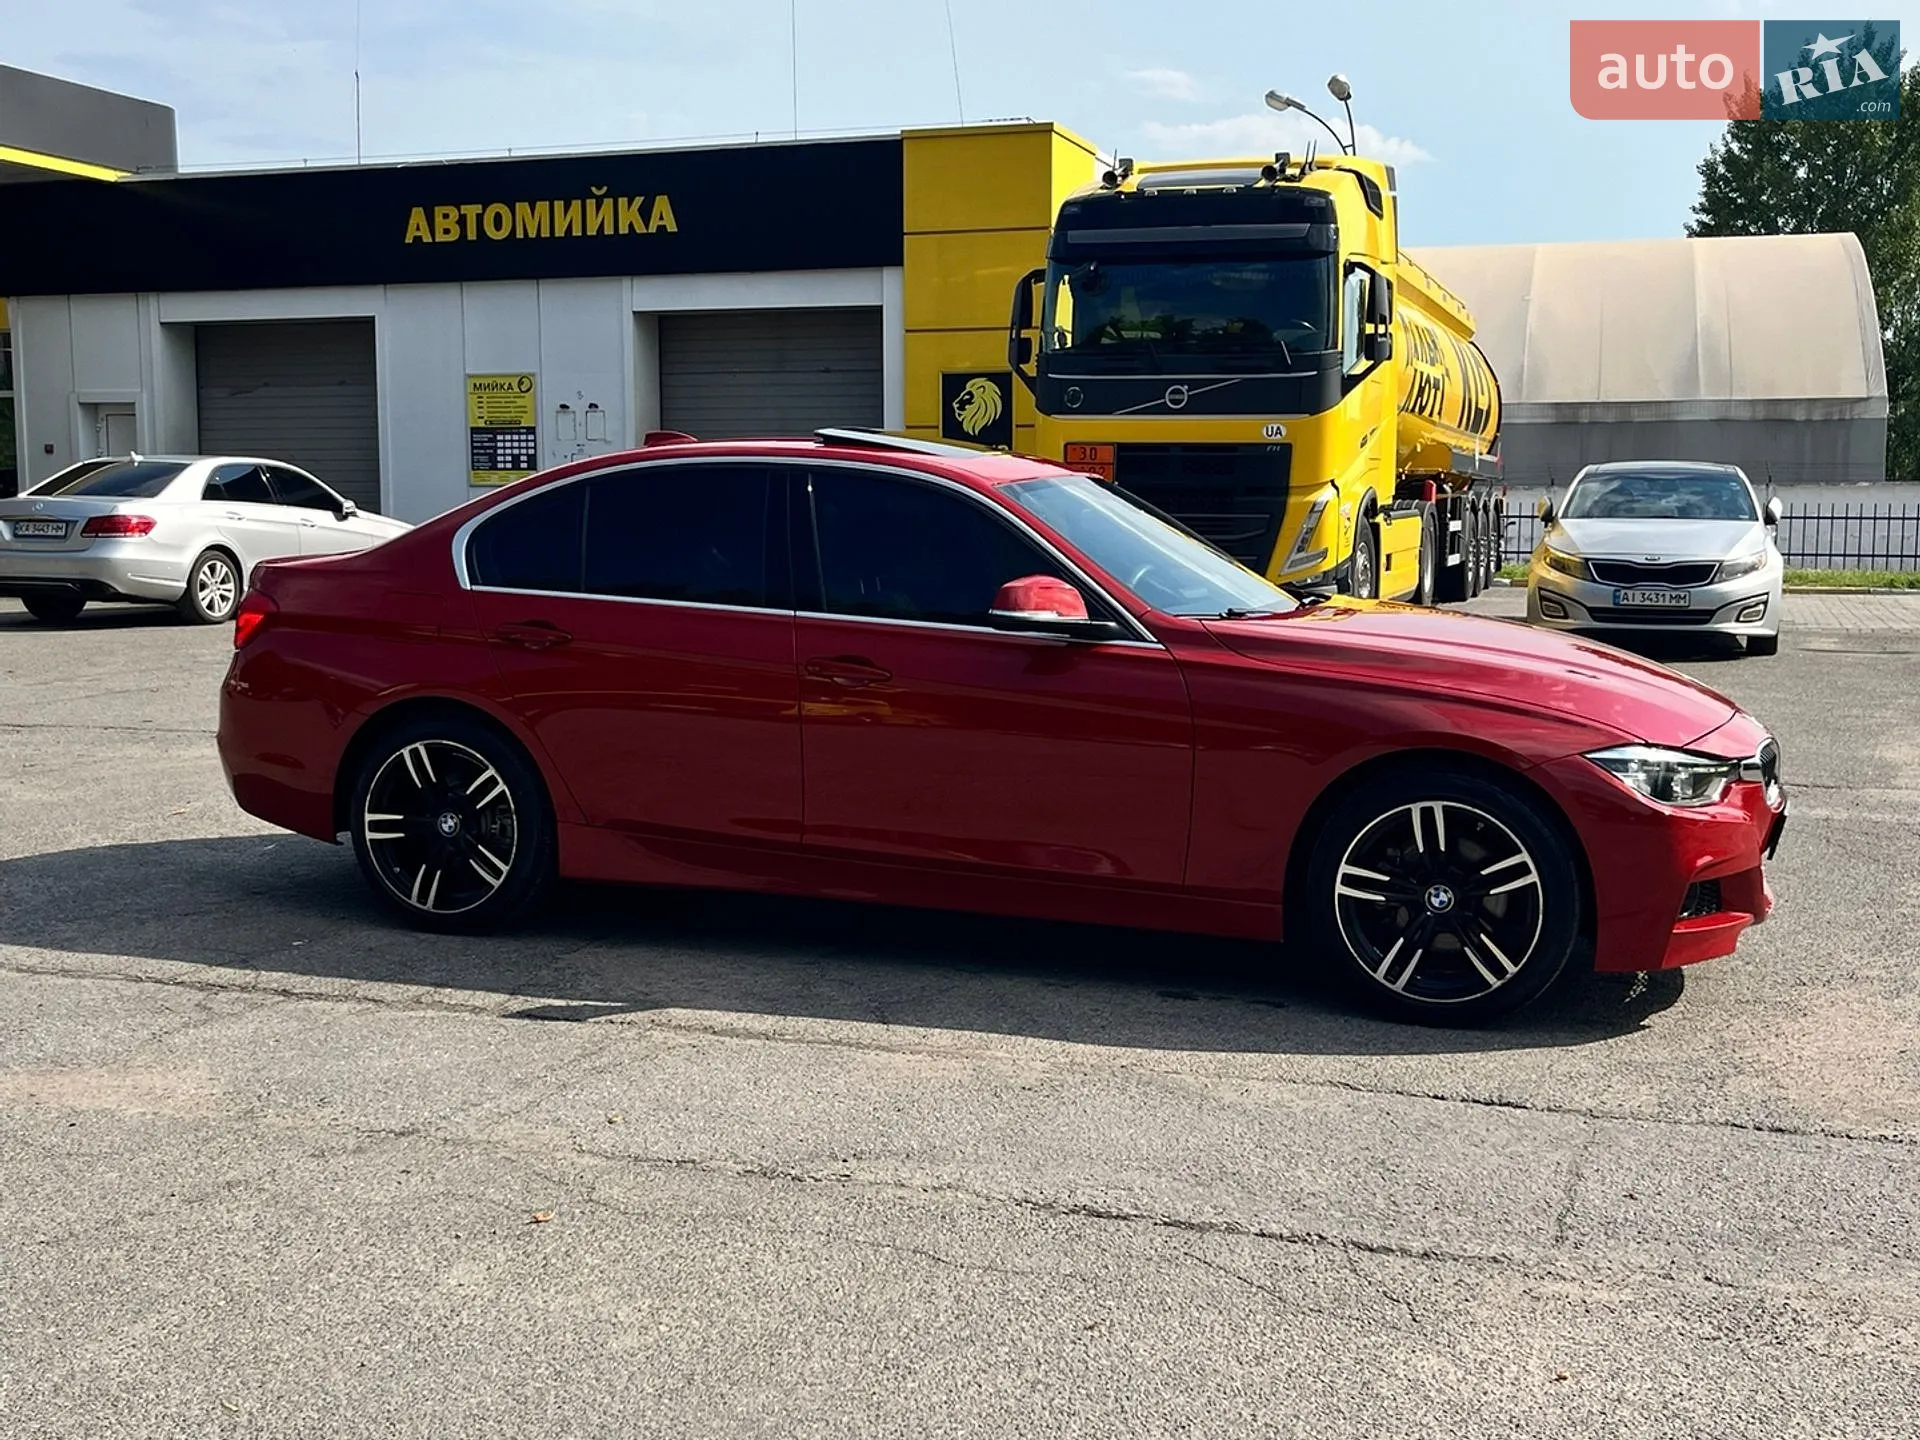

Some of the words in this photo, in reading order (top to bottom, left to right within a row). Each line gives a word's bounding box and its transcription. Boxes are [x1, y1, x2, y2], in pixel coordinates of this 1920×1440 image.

[404, 186, 678, 243] АВТОМИЙКА
[473, 380, 514, 392] МИЙКА
[1265, 425, 1283, 438] UA
[1079, 446, 1098, 461] 30
[1621, 592, 1635, 603] AI
[1639, 592, 1666, 603] 3431
[1669, 593, 1687, 604] MM
